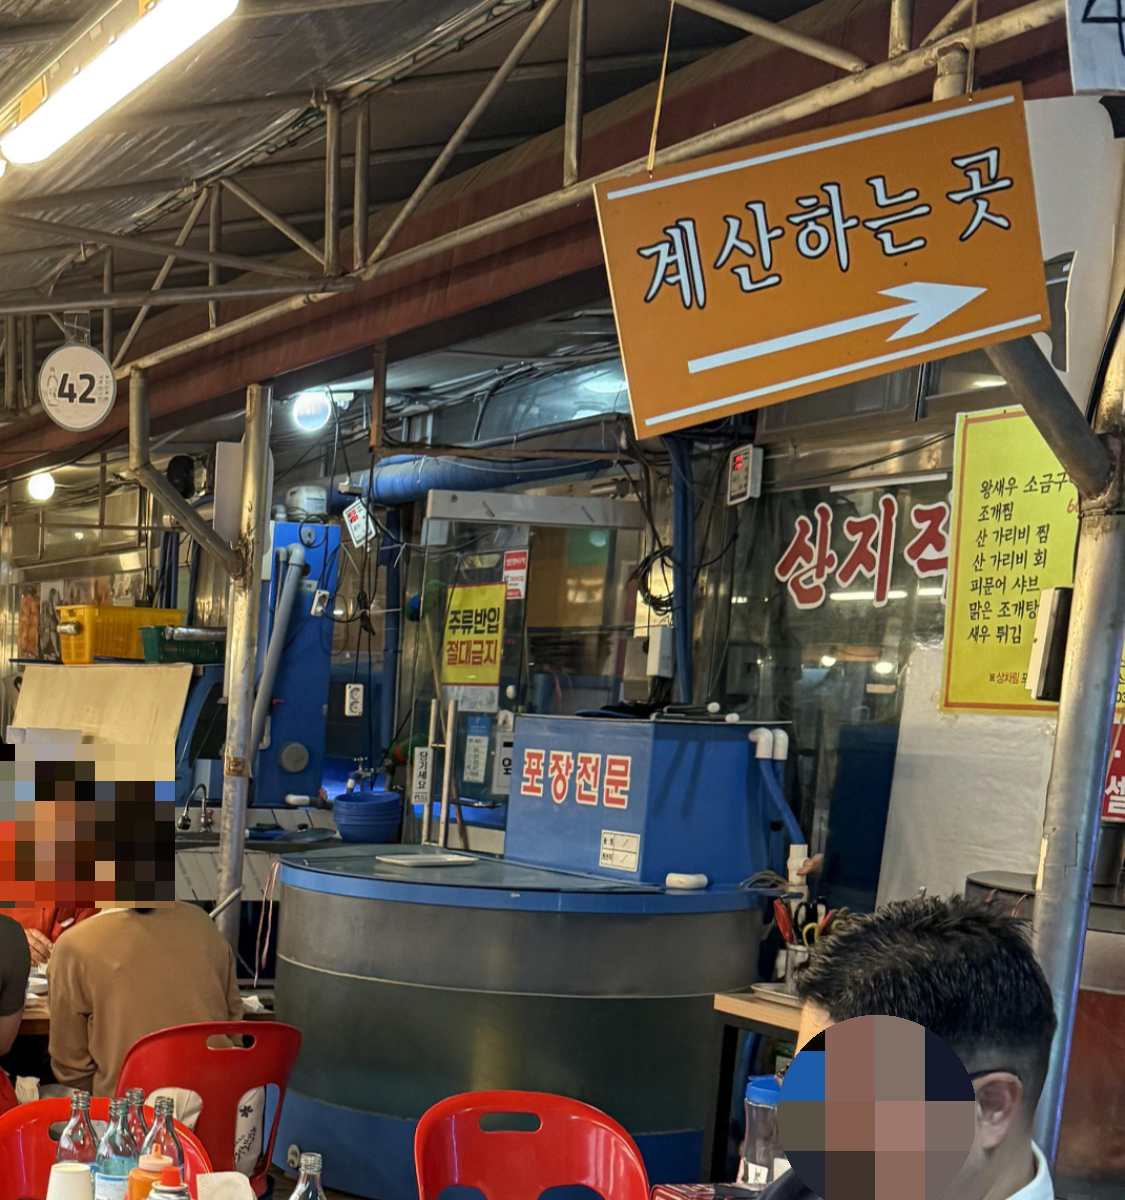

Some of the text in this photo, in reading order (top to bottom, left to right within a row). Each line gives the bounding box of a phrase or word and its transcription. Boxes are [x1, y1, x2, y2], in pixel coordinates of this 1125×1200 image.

[638, 147, 1013, 309] 계산하는 곳
[57, 373, 96, 404] 42
[980, 471, 1070, 500] 왕새우 소금구
[978, 501, 1014, 523] 조개찜
[976, 523, 1050, 548] 산 가리비 찜
[972, 548, 1047, 572] 산 가리비 회
[970, 574, 1040, 596] 피문어 샤브
[448, 606, 501, 635] 주류반입
[969, 599, 1039, 621] 맑은 조개탕
[967, 624, 1022, 645] 새우 튀김
[446, 639, 498, 667] 절대금지
[417, 751, 429, 790] 당기세요
[521, 748, 632, 809] 포장전문
